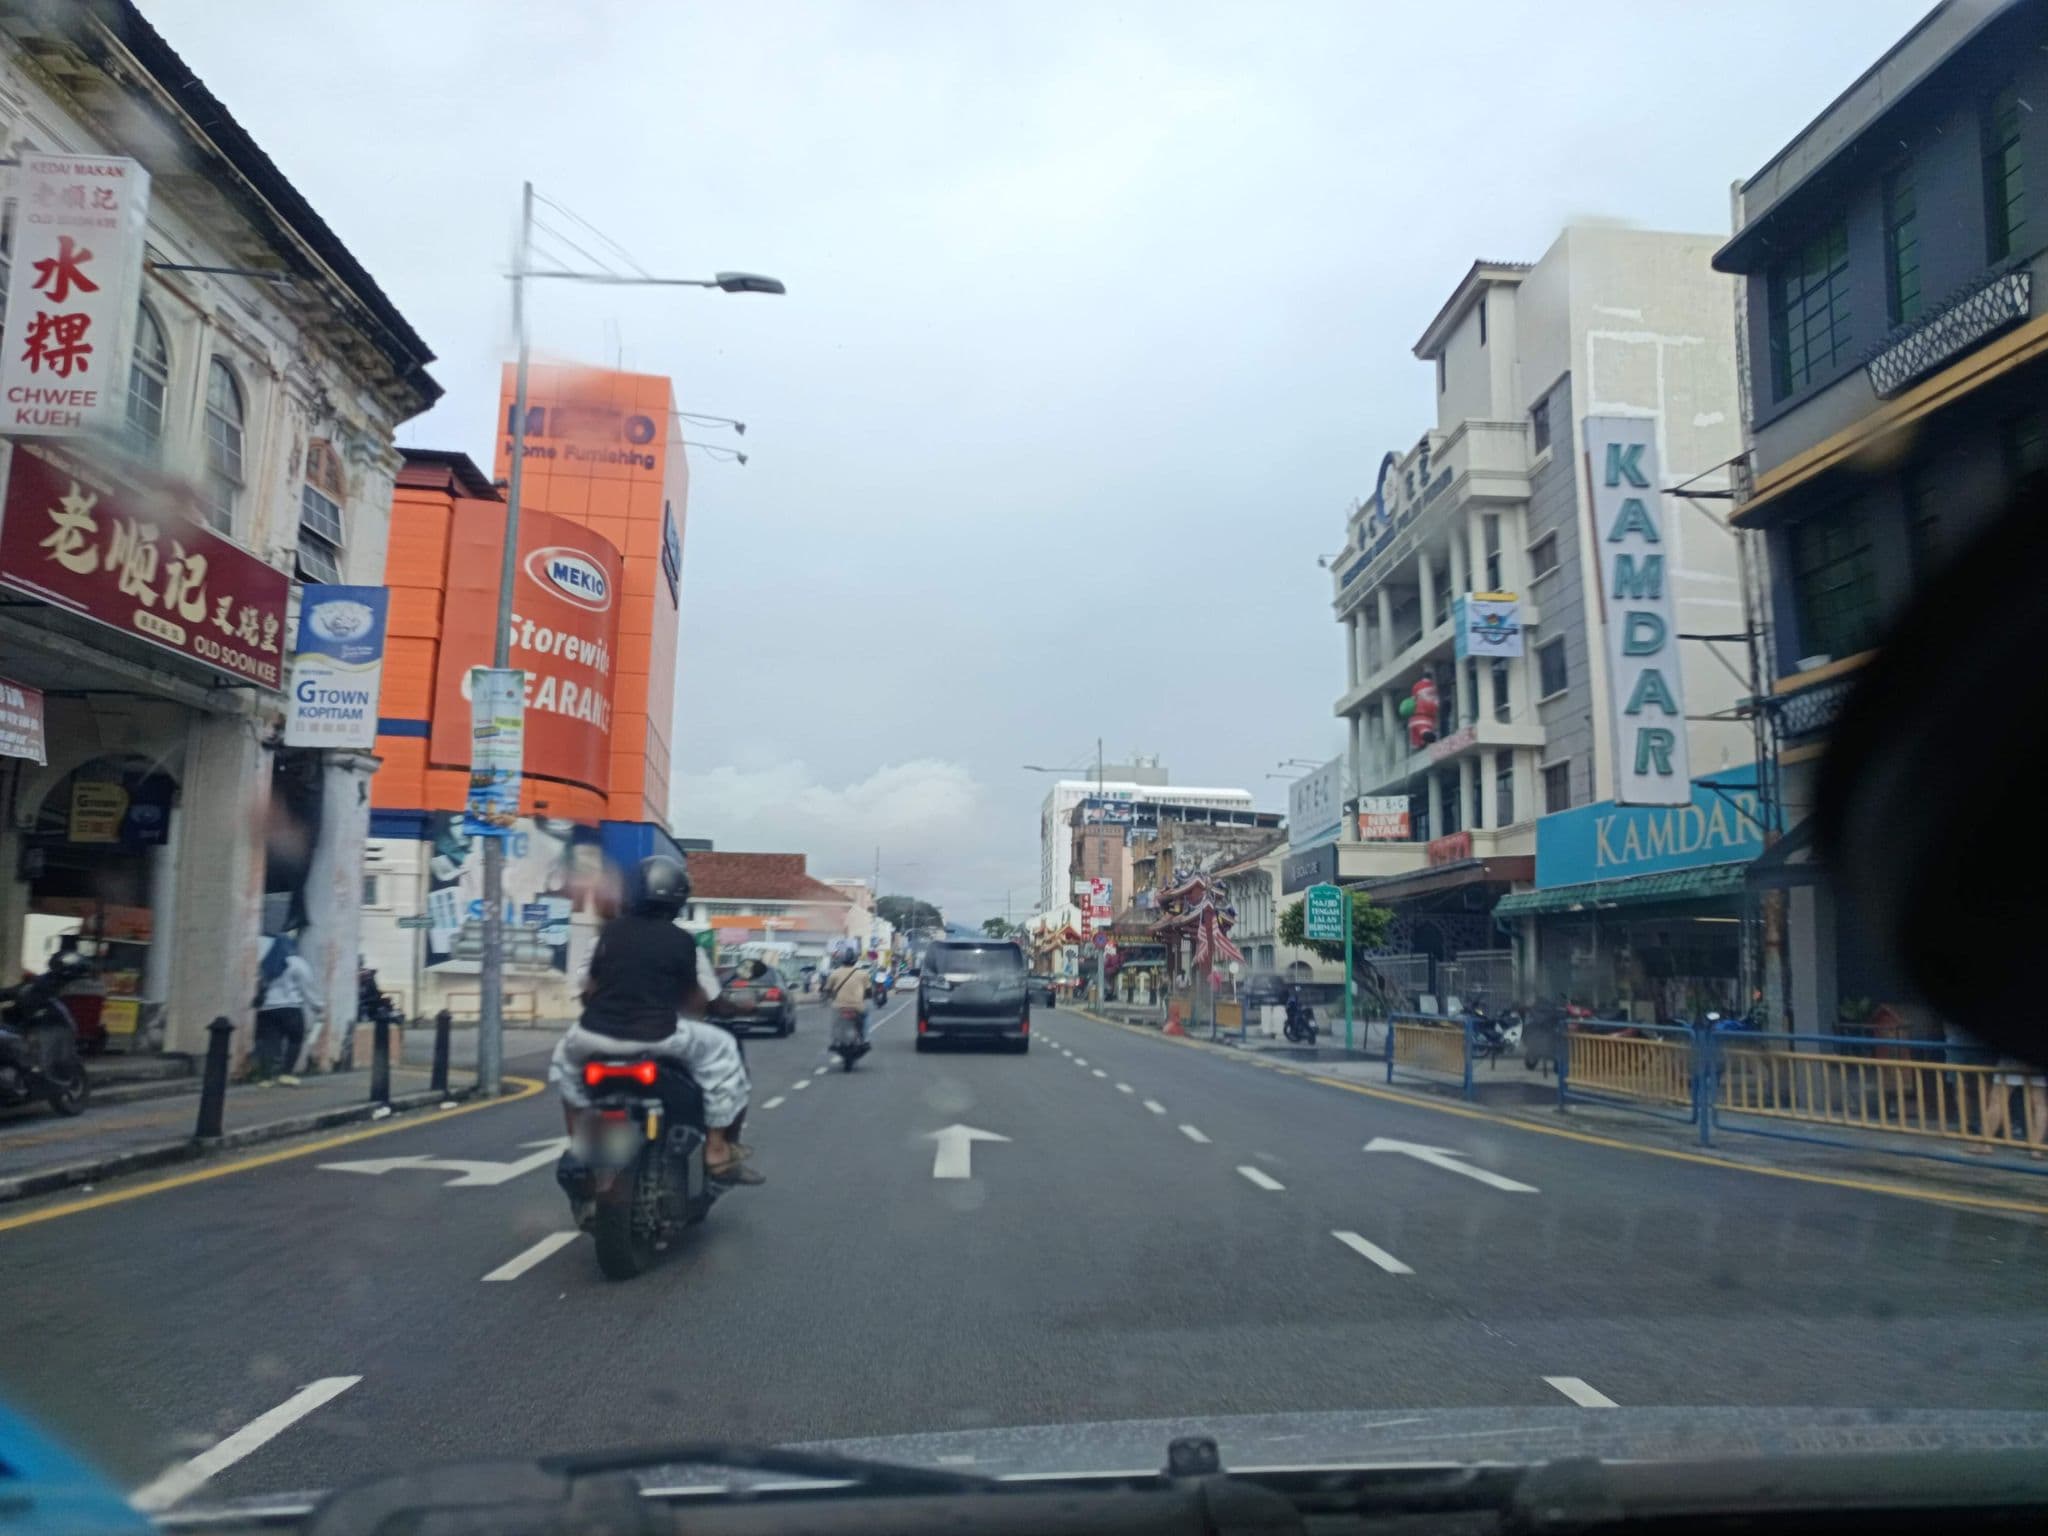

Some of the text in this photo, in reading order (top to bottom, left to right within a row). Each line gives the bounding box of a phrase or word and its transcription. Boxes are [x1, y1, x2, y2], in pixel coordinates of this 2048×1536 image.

[74, 163, 125, 177] MAKAN
[8, 387, 97, 408] CHWEE
[15, 409, 81, 428] KUEH
[553, 561, 605, 596] MEKIO
[1604, 441, 1678, 777] KAMDAR
[194, 635, 277, 683] OLD SOON KEE
[298, 706, 364, 720] KOPITIAM
[1594, 793, 1764, 868] KAMDAR
[1311, 907, 1340, 915] TENGAH
[1313, 915, 1337, 923] JALAN
